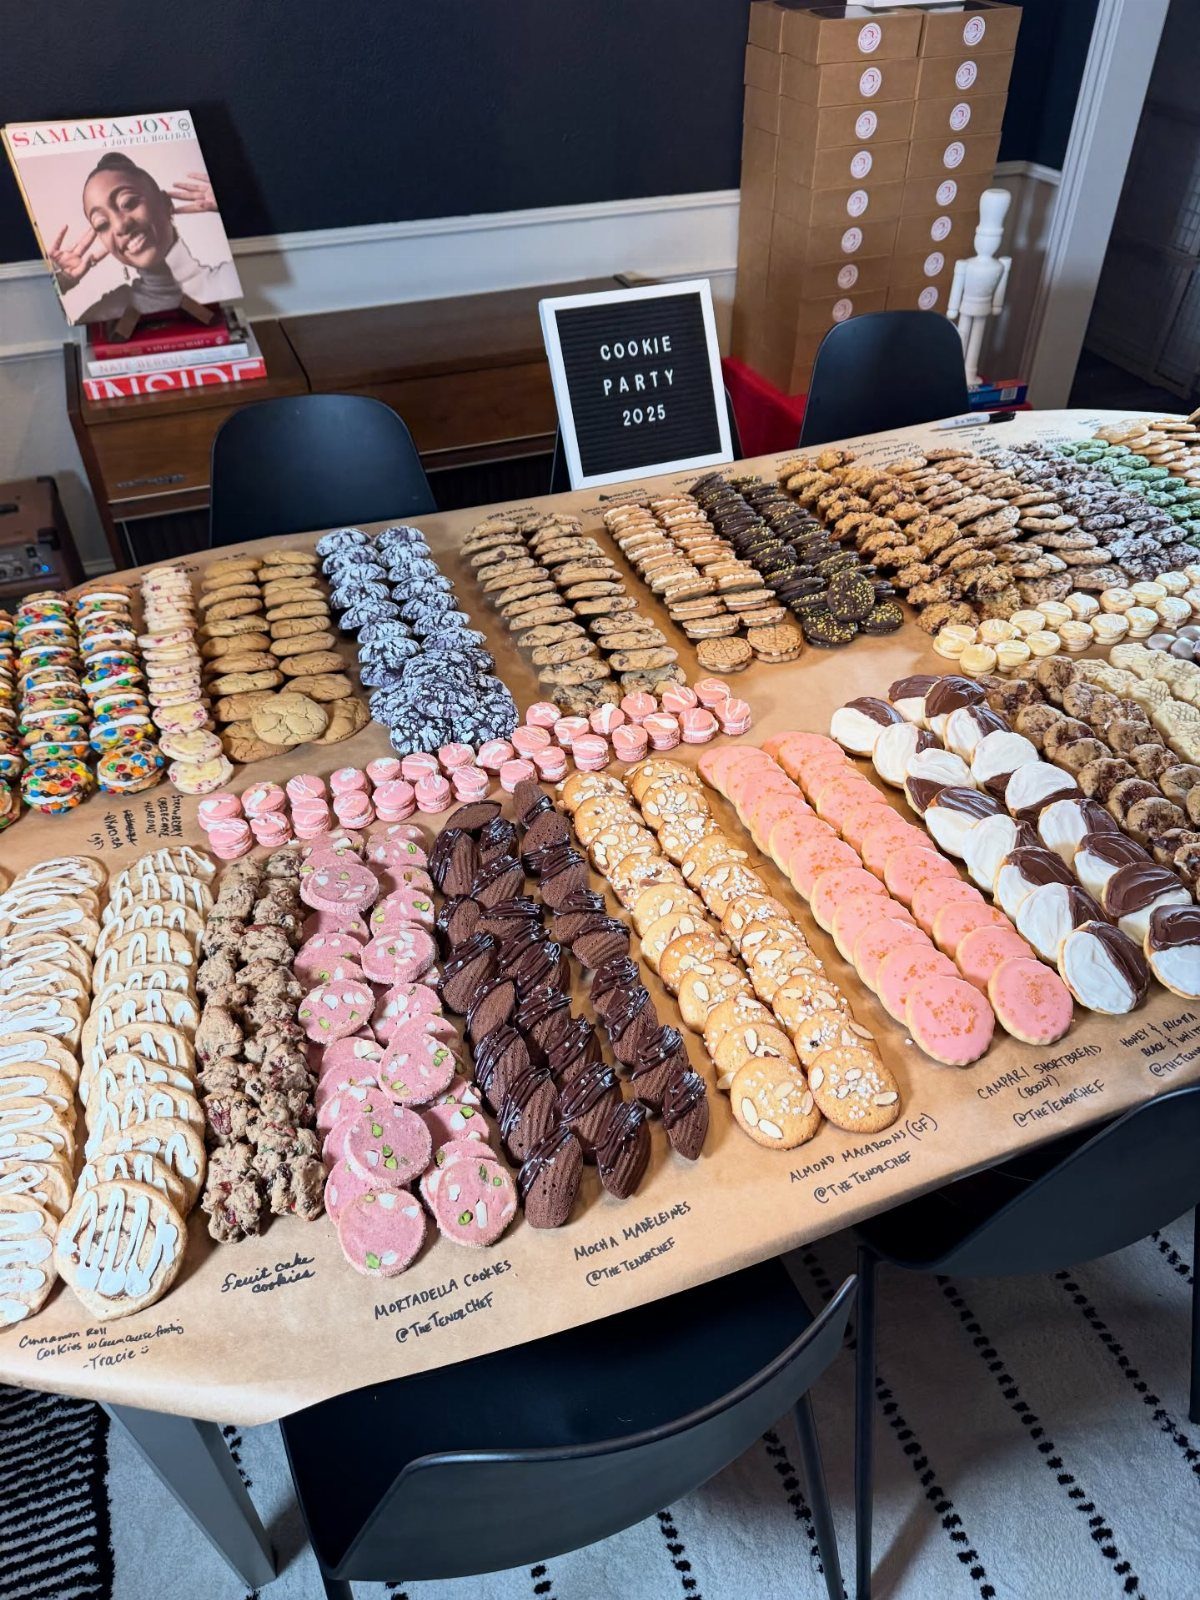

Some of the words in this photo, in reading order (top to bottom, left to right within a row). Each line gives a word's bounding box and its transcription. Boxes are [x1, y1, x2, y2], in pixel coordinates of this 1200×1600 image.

[12, 123, 124, 148] SAMARA
[129, 116, 173, 134] JOY
[600, 335, 672, 361] COOKIE
[603, 369, 674, 396] PARTY
[622, 404, 666, 426] 2025
[1120, 1028, 1149, 1048] HONEY
[977, 1066, 1030, 1100] CAMPARI
[1033, 1045, 1102, 1075] SHORTBREAD
[1017, 1074, 1060, 1099] (BOOZY)
[789, 1155, 835, 1183] ALMOND
[841, 1129, 906, 1162] MACAROONS
[905, 1112, 938, 1141] (GF)
[573, 1236, 619, 1261] MOCHA
[622, 1201, 692, 1240] MADELEINES
[374, 1278, 459, 1320] MORTADELLA
